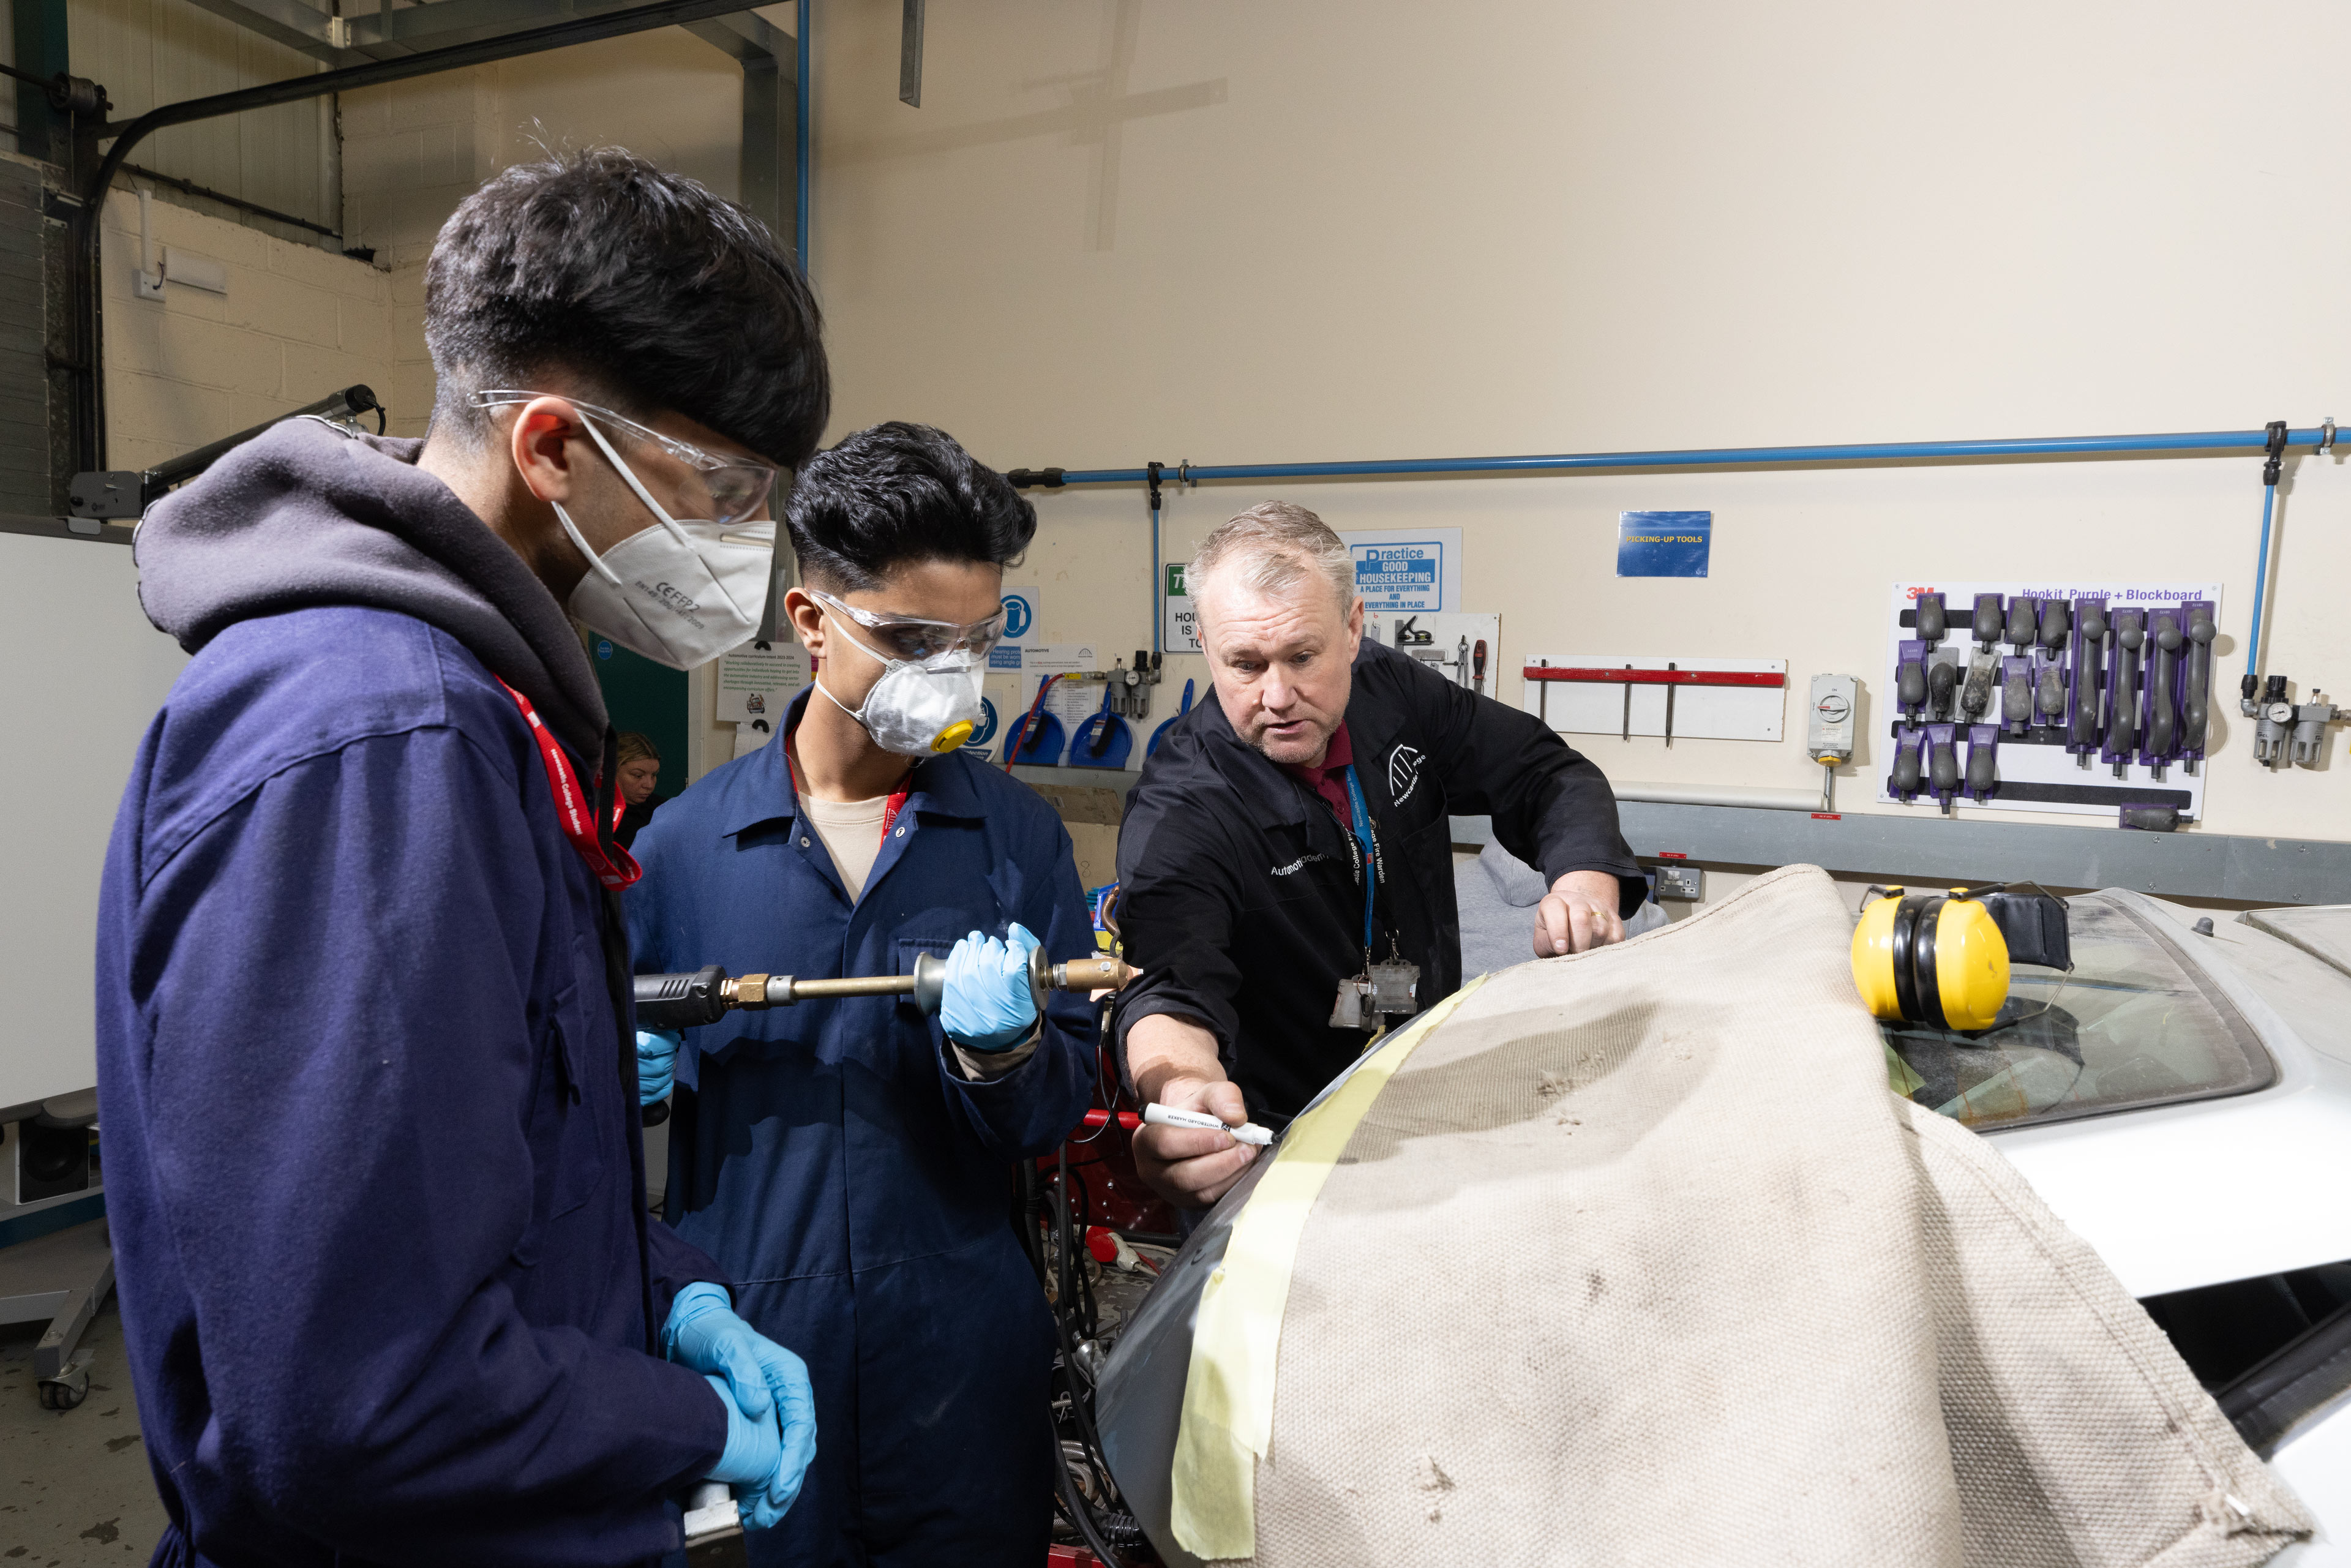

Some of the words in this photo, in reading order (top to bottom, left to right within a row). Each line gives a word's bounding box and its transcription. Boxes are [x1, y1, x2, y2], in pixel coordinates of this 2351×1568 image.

[1365, 547, 1424, 571] Practice
[1382, 561, 1408, 572] GOOD
[1359, 572, 1431, 583] HOUSEKEEPING
[670, 591, 700, 612] FFP2
[2022, 589, 2063, 600] Hookit
[2069, 589, 2111, 600] Purple
[2126, 589, 2202, 601] Blockboard
[1182, 626, 1192, 635] IS
[1349, 782, 1358, 801] College
[1394, 775, 1418, 807] Newcastle
[561, 783, 574, 809] College
[569, 808, 583, 835] Student
[1351, 842, 1360, 869] College
[1081, 860, 1091, 877] 8
[1271, 858, 1303, 876] Automoti
[1375, 857, 1385, 883] Warden
[1188, 1118, 1219, 1128] WHITEBOARD
